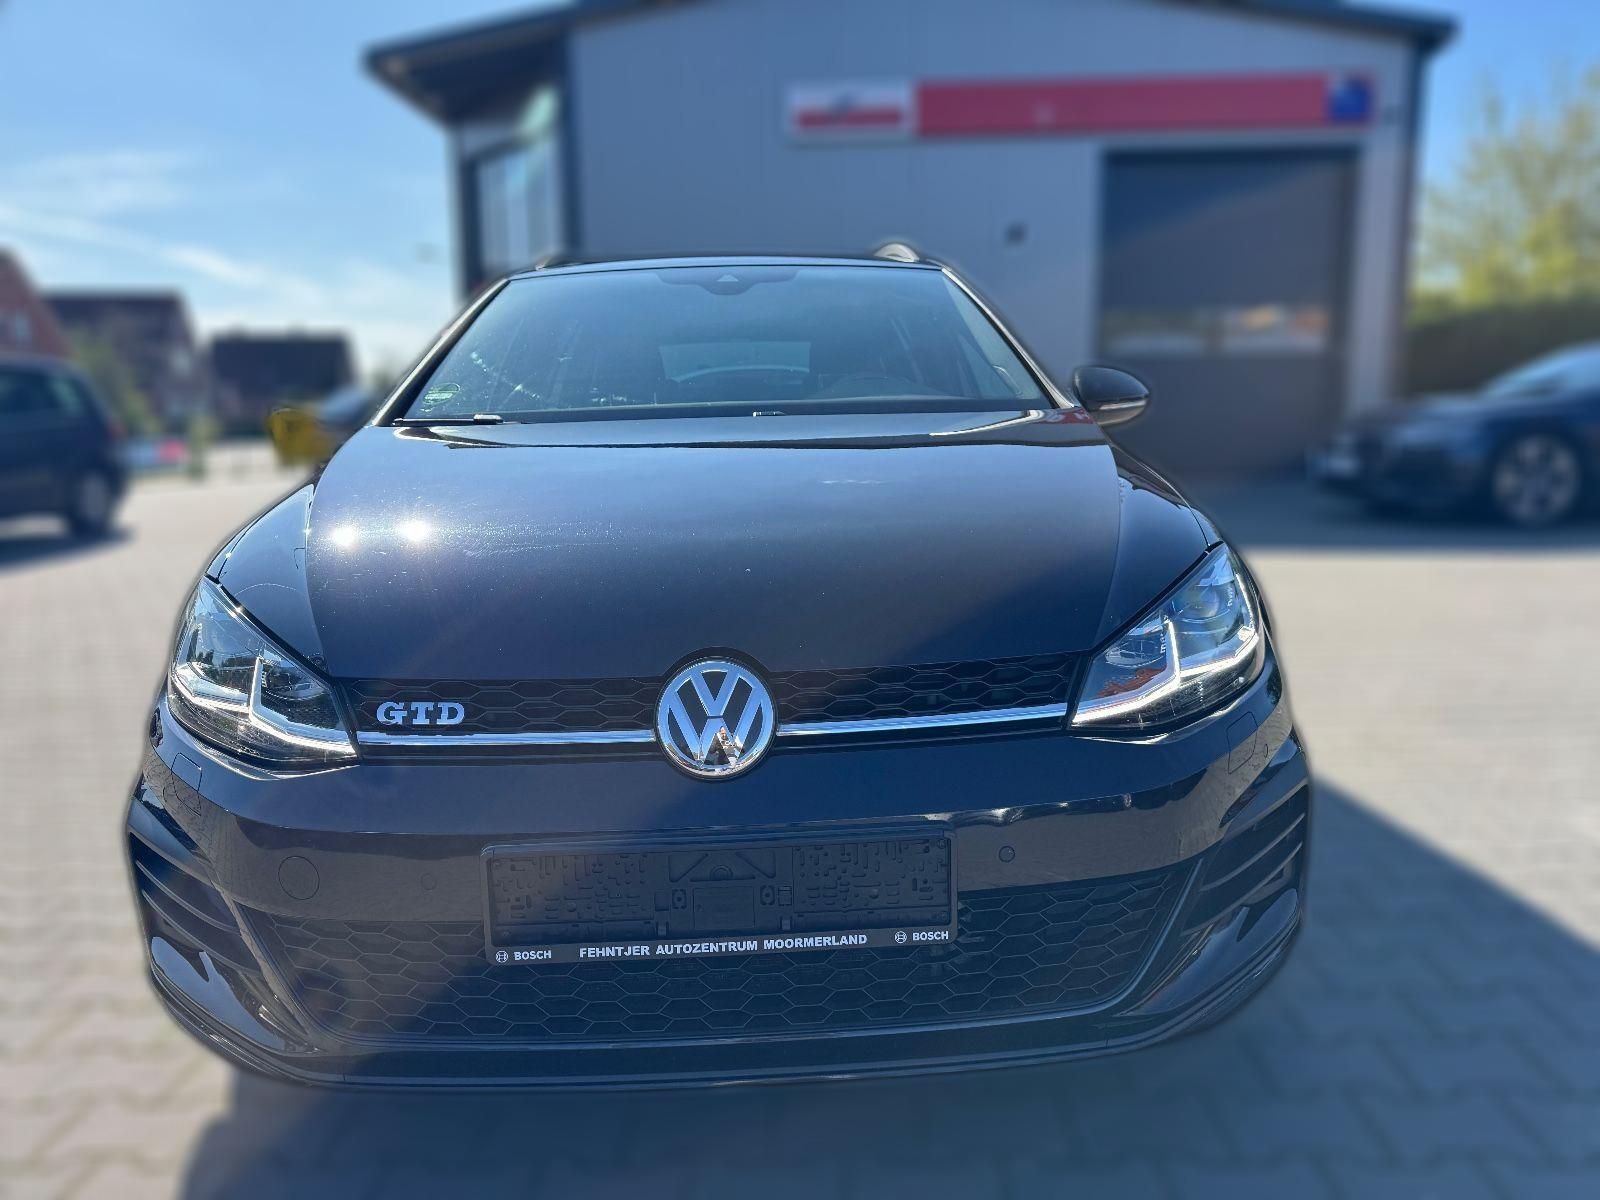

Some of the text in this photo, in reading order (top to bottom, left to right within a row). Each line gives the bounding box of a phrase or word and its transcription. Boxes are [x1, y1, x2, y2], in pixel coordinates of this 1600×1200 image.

[376, 701, 465, 726] GTD
[912, 930, 949, 942] BOSCH
[513, 949, 552, 962] BOSCH
[579, 934, 868, 959] FEHNTJER AUTOZENTRUM MOORMERLAND
